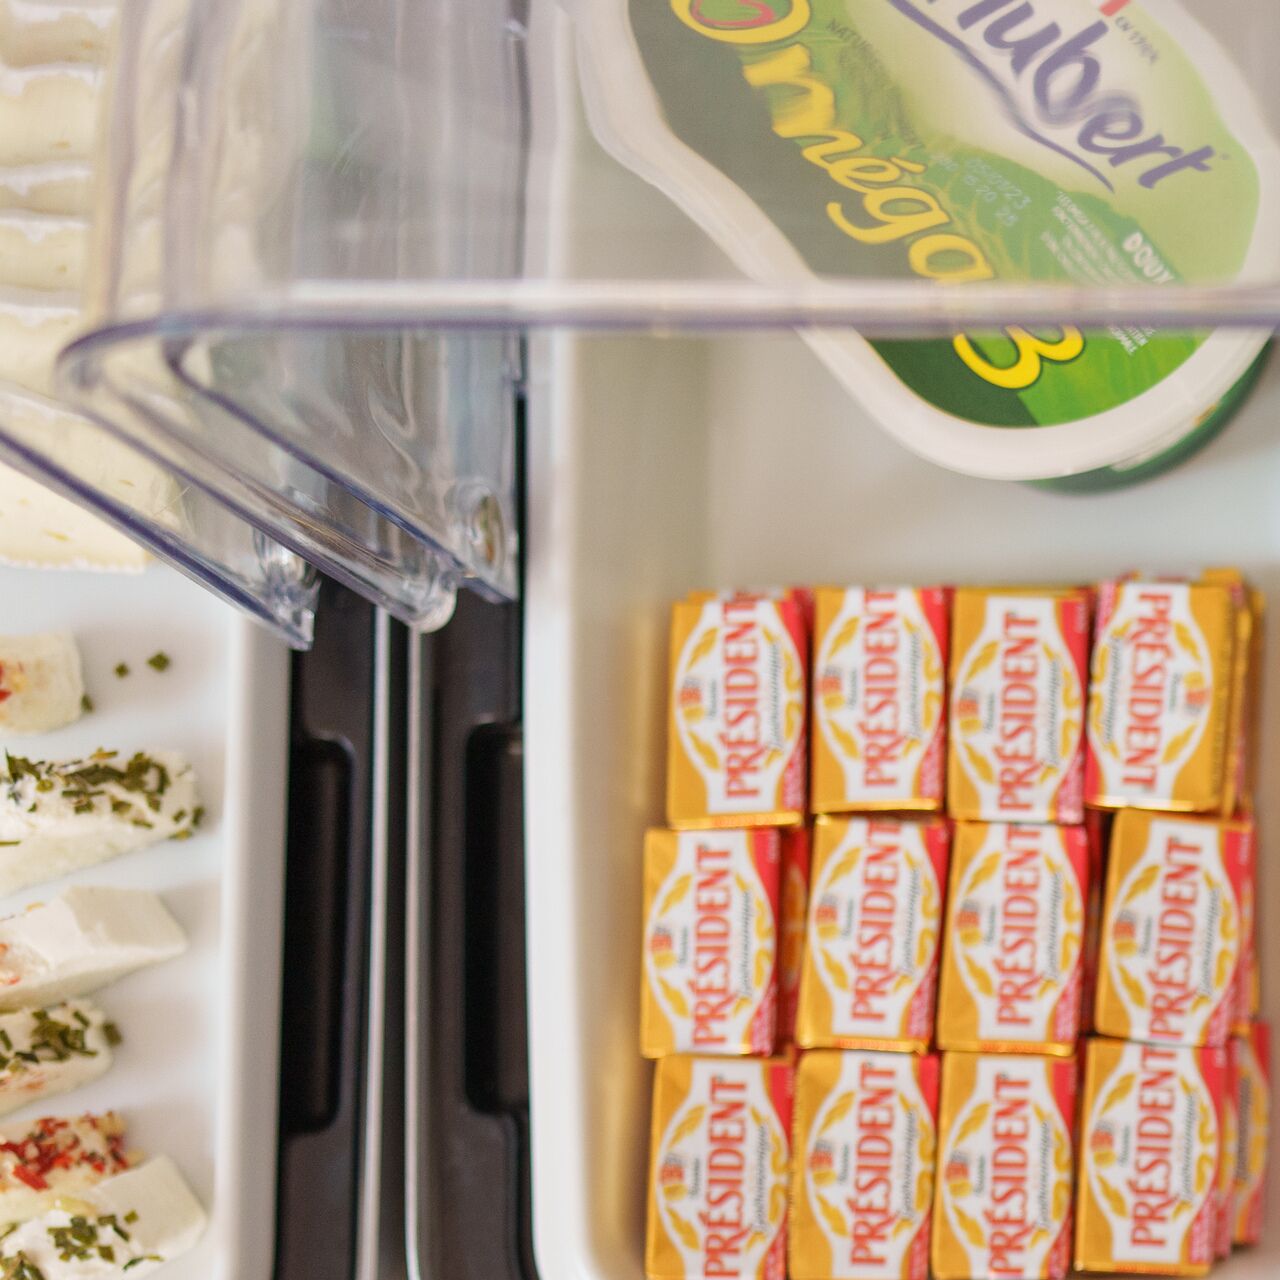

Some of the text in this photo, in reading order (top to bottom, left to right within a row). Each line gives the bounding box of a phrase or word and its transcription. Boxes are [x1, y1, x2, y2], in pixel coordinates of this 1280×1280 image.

[930, 0, 1215, 189] ubert
[1122, 232, 1174, 284] DOUX
[859, 588, 904, 788] PRÉSIDENT
[993, 611, 1041, 812] PRÉSIDENT
[1122, 592, 1173, 790] PRÉSIDENT
[691, 844, 746, 1047] PRÉSIDENT
[851, 821, 906, 1022] PRÉSIDENT
[996, 826, 1051, 1028] PRÉSIDENT
[1148, 836, 1203, 1041] PRÉSIDENT
[704, 1075, 759, 1280] PRÉSIDENT
[851, 1063, 902, 1269] PRÉSIDENT
[988, 1073, 1044, 1278] PRÉSIDENT
[1129, 1048, 1184, 1250] PRÉSIDENT
